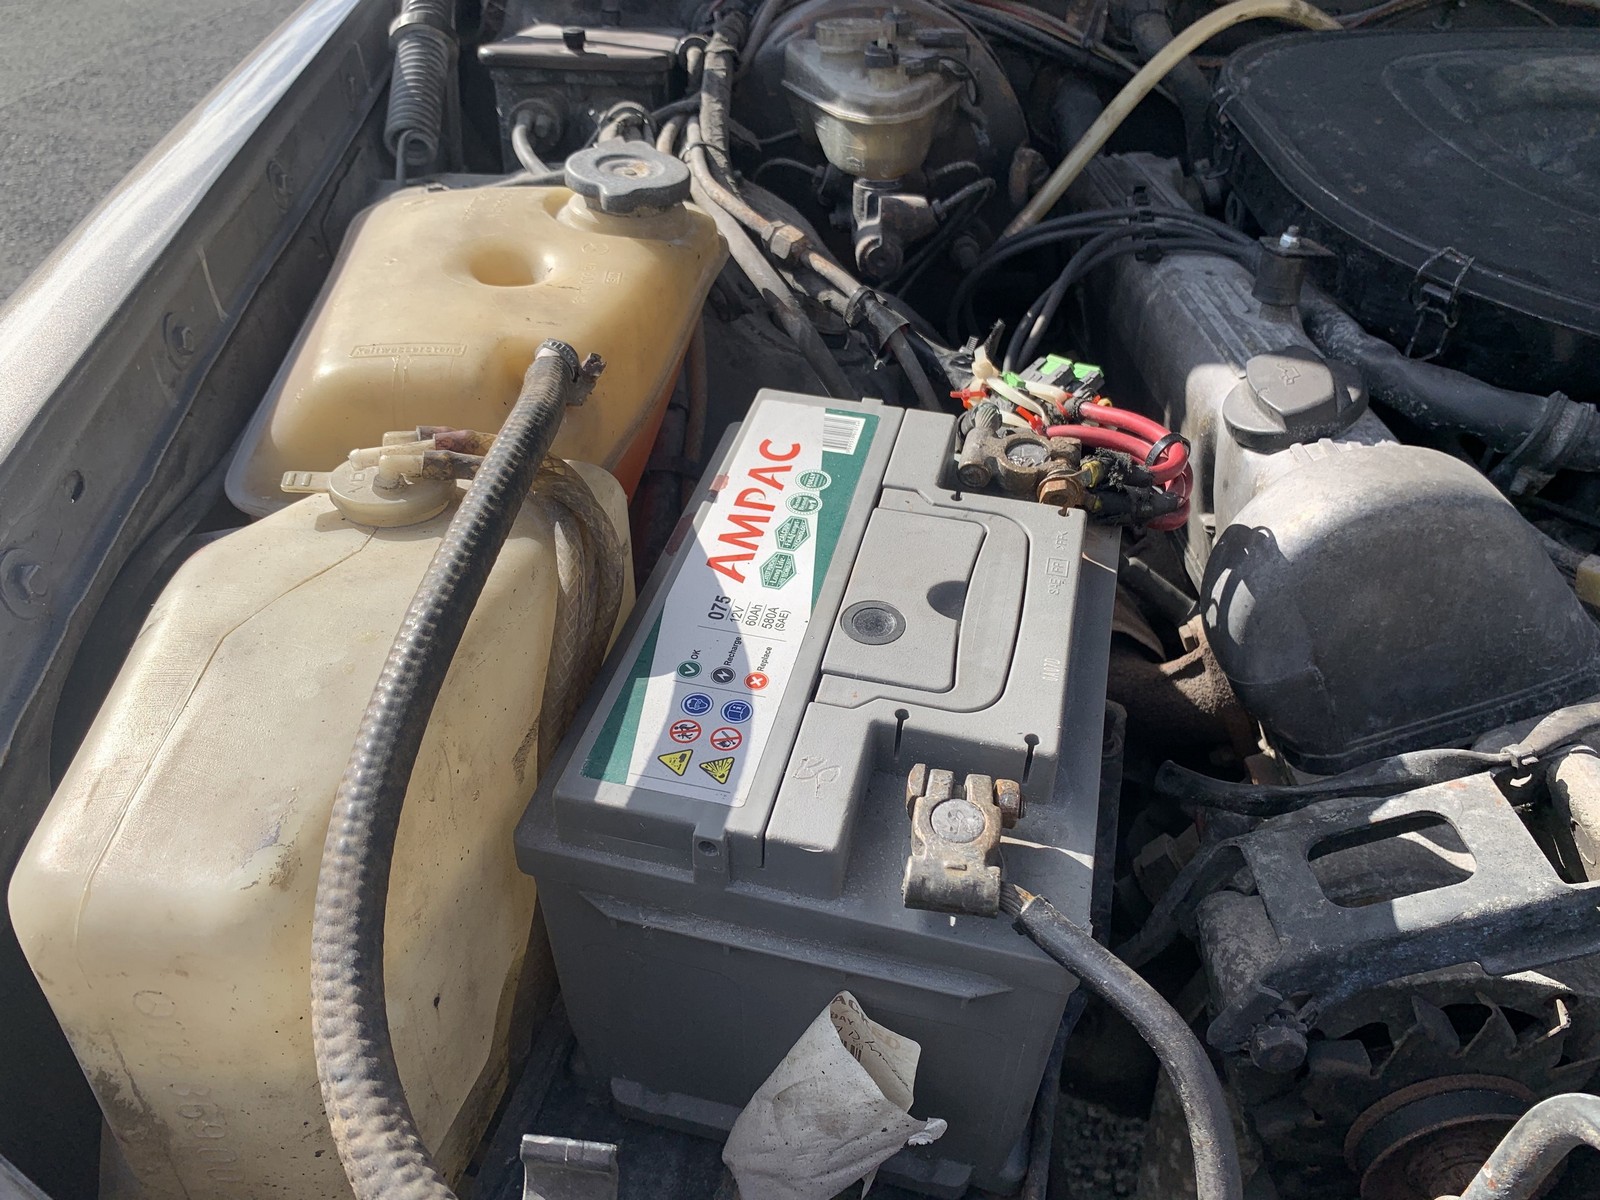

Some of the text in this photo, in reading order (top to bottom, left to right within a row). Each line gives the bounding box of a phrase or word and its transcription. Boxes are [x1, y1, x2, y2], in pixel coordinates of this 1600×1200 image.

[706, 438, 801, 584] AMPAC
[775, 555, 787, 570] Life
[769, 568, 783, 584] Long
[707, 595, 732, 620] 075
[729, 605, 745, 623] 12V
[745, 604, 763, 627] 60Ah
[761, 606, 780, 630] 580A
[774, 609, 792, 632] (SAE)
[691, 649, 701, 660] OK
[723, 636, 742, 667] Recharge
[756, 646, 773, 672] Replace
